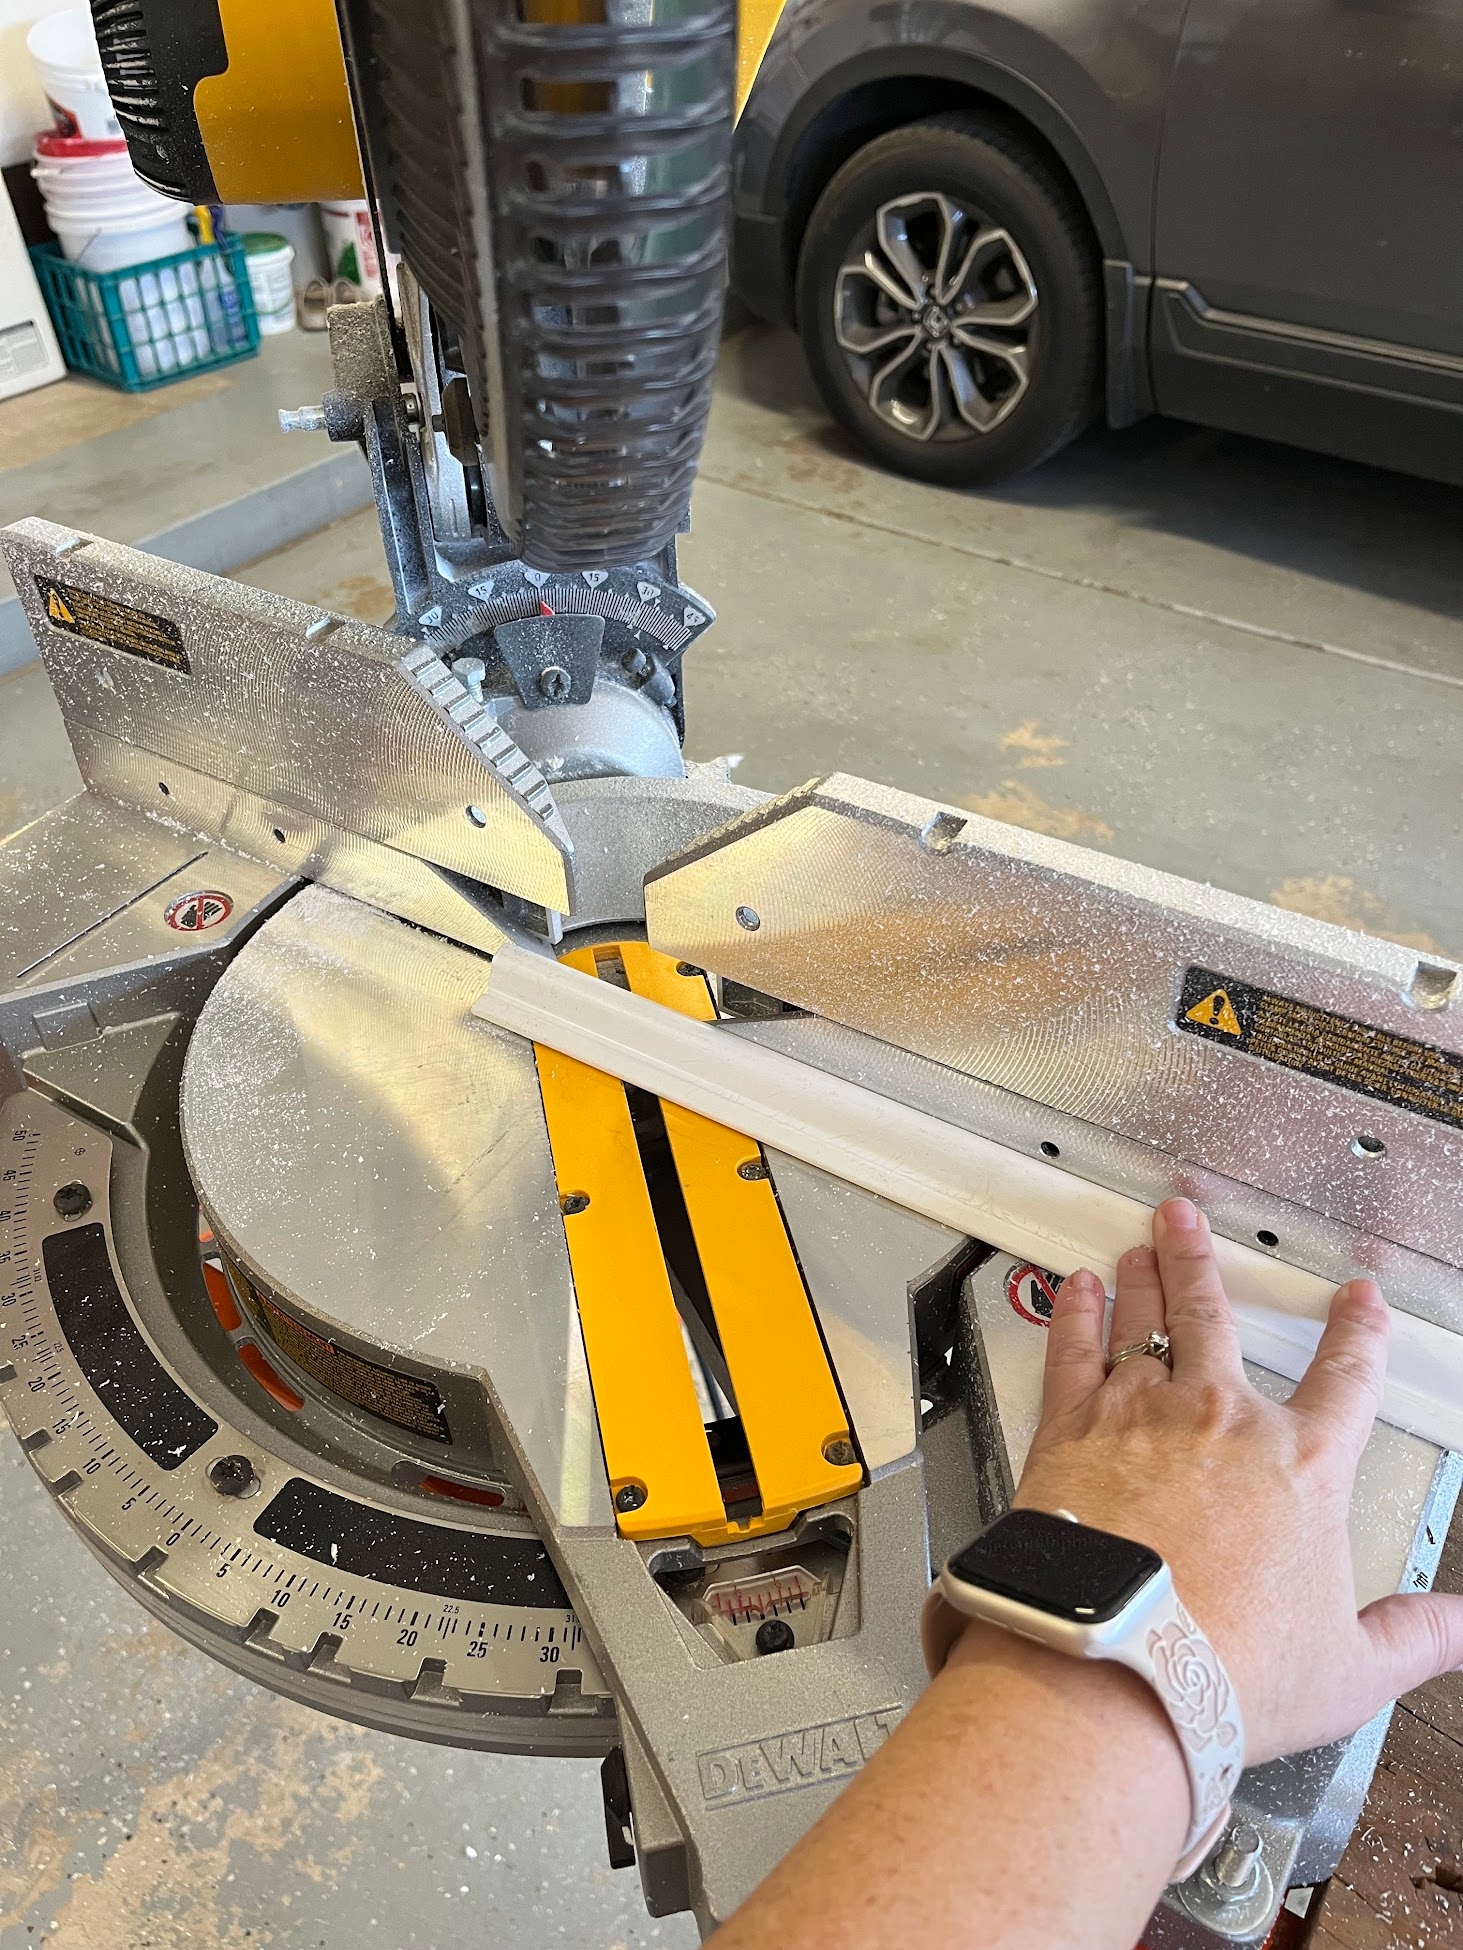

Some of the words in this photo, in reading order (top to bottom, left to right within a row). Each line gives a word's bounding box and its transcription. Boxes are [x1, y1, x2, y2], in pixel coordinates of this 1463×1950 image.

[475, 585, 488, 596] 15
[13, 1130, 27, 1141] 50
[3, 1169, 17, 1181] 45
[2, 1292, 17, 1307] 30
[11, 1334, 29, 1351] 25
[28, 1376, 46, 1393] 20
[52, 1418, 71, 1435] 15
[83, 1458, 102, 1475] 10
[121, 1497, 137, 1511] 5
[166, 1532, 182, 1547] 0
[216, 1563, 232, 1579] 5
[270, 1589, 291, 1608] 10
[443, 1604, 460, 1614] 22.5
[332, 1611, 353, 1631] 15
[396, 1628, 419, 1647] 20
[466, 1641, 489, 1658] 25
[539, 1646, 560, 1662] 30
